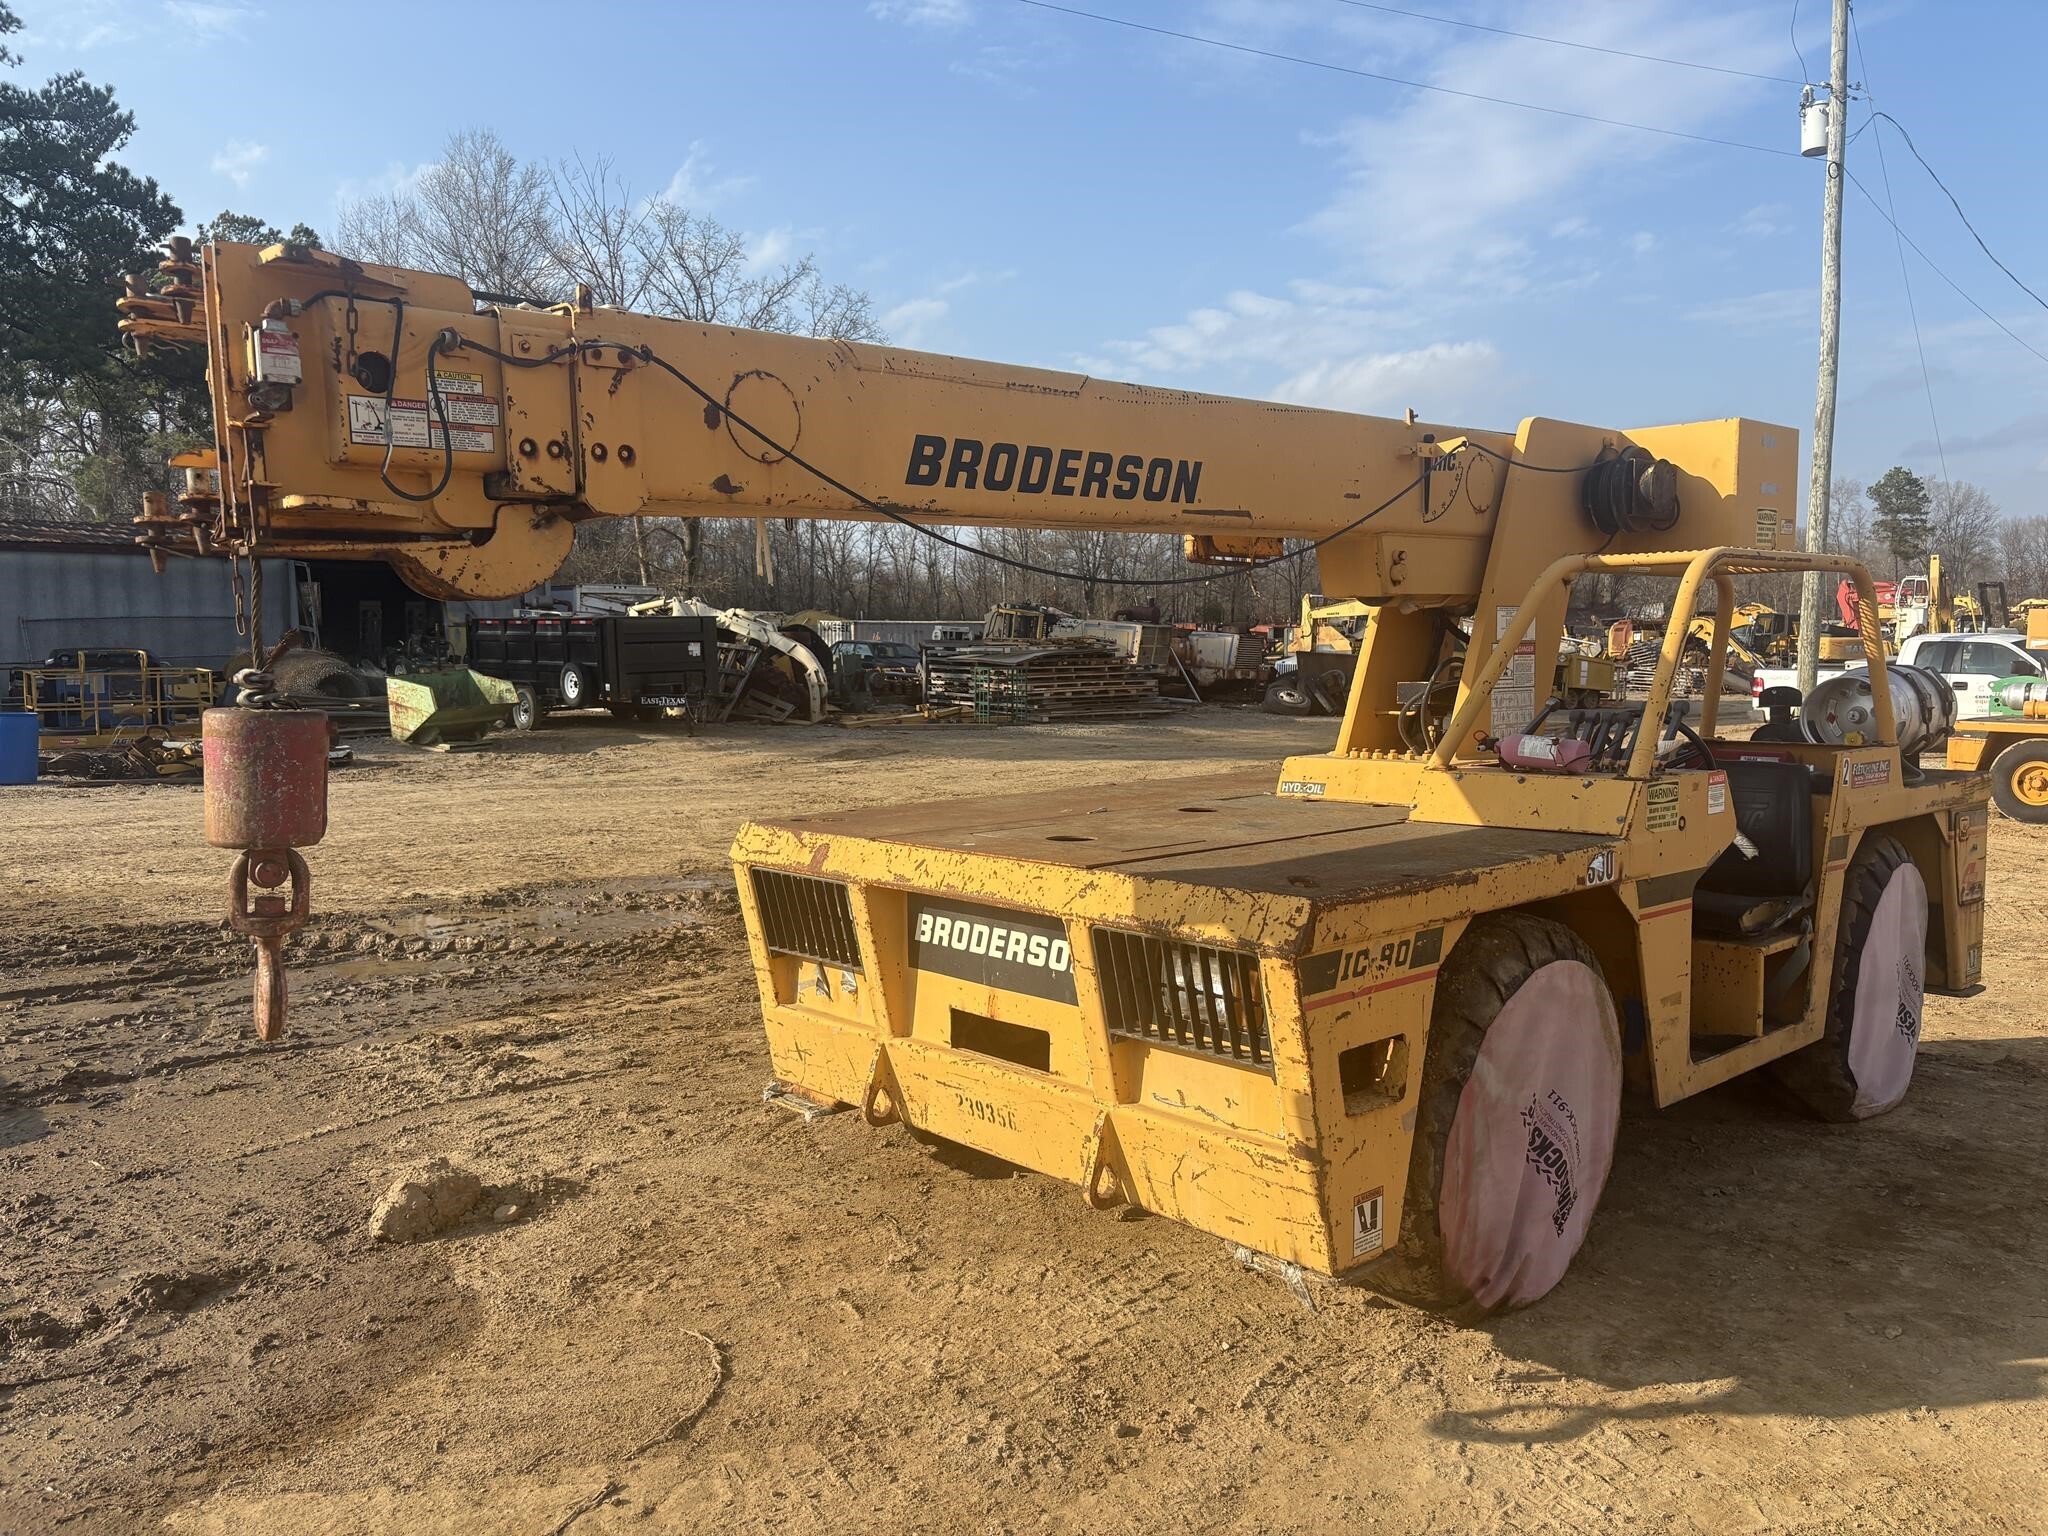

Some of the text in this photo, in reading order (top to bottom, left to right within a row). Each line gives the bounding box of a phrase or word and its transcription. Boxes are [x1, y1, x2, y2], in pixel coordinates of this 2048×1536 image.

[443, 372, 472, 380] CAUTION
[396, 401, 427, 409] DANGER
[904, 434, 1203, 504] BRODERSON
[660, 696, 686, 704] TEXAS
[1843, 759, 1849, 785] 2
[1306, 783, 1324, 794] OIL
[1648, 786, 1678, 801] WARNING
[915, 913, 1075, 974] BRODERSO
